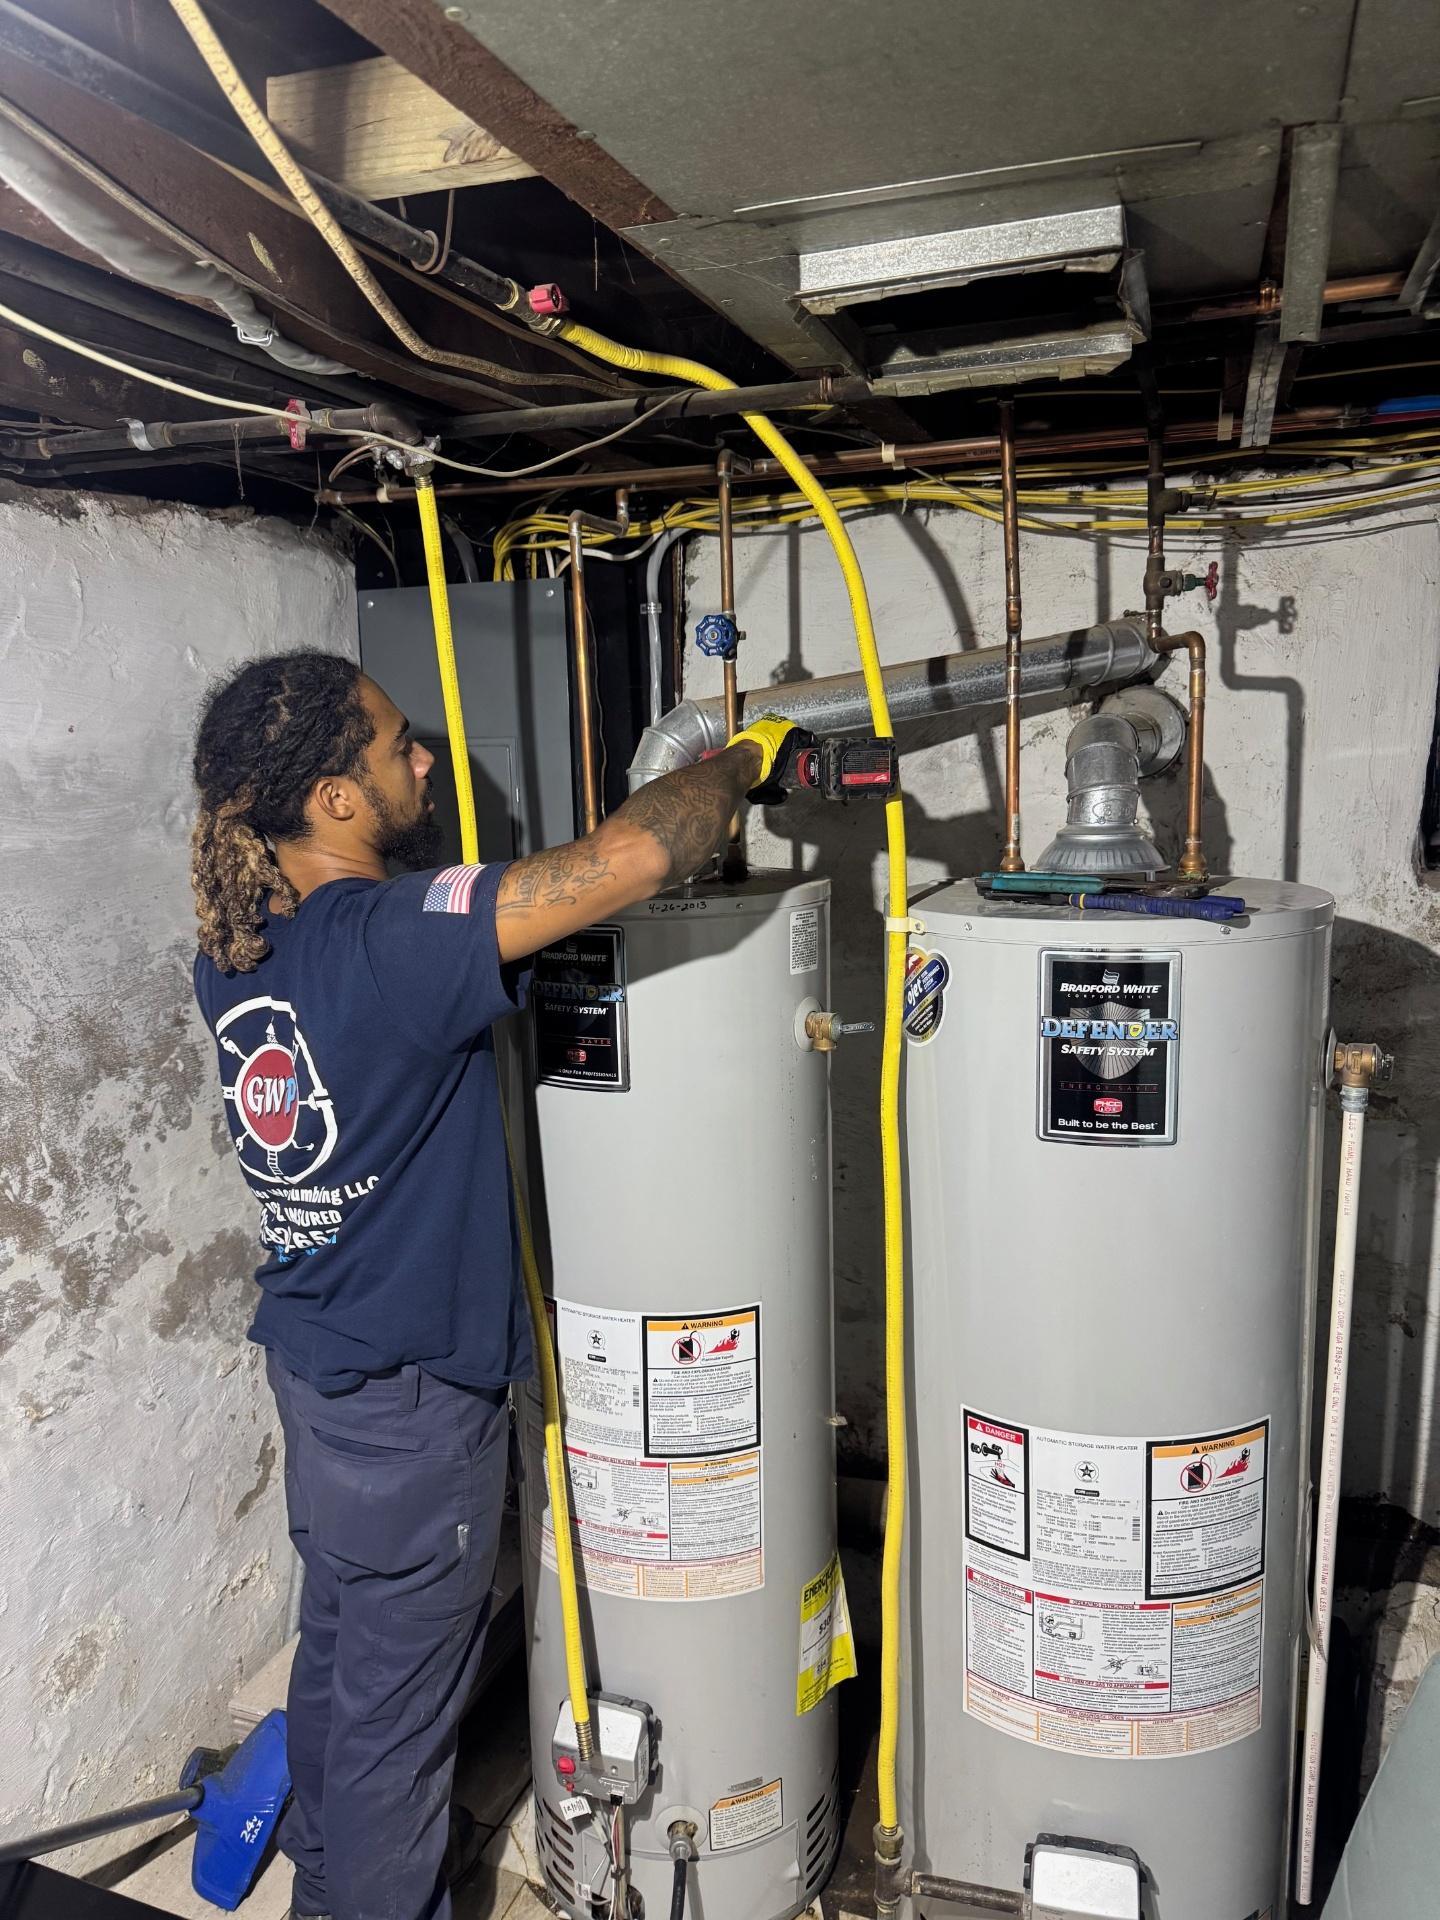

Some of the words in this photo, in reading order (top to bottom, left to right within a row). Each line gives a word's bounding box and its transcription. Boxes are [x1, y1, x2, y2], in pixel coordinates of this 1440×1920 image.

[648, 901, 707, 913] 4-26-2013
[580, 953, 607, 962] WHITE
[533, 980, 624, 1002] DEFENDER
[1060, 982, 1120, 993] BRADFORD
[1123, 984, 1161, 994] WHITE
[544, 1003, 571, 1012] SAFETY
[573, 1005, 608, 1015] SYSTEM
[1041, 1016, 1178, 1040] DEFENDER
[1060, 1044, 1105, 1056] SAFETY
[1106, 1046, 1156, 1056] SYSTEM
[246, 1075, 297, 1117] GWP
[1058, 1118, 1080, 1127] Built
[1095, 1121, 1109, 1129] be
[1111, 1122, 1129, 1130] the
[1131, 1122, 1156, 1130] Best
[690, 1320, 724, 1329] WARNING
[985, 1426, 1016, 1442] DANGER
[1036, 1436, 1067, 1446] AUTOMATIC
[1068, 1441, 1094, 1449] STORAGE
[1201, 1439, 1236, 1453] WARNING
[735, 1790, 764, 1804] WARNING
